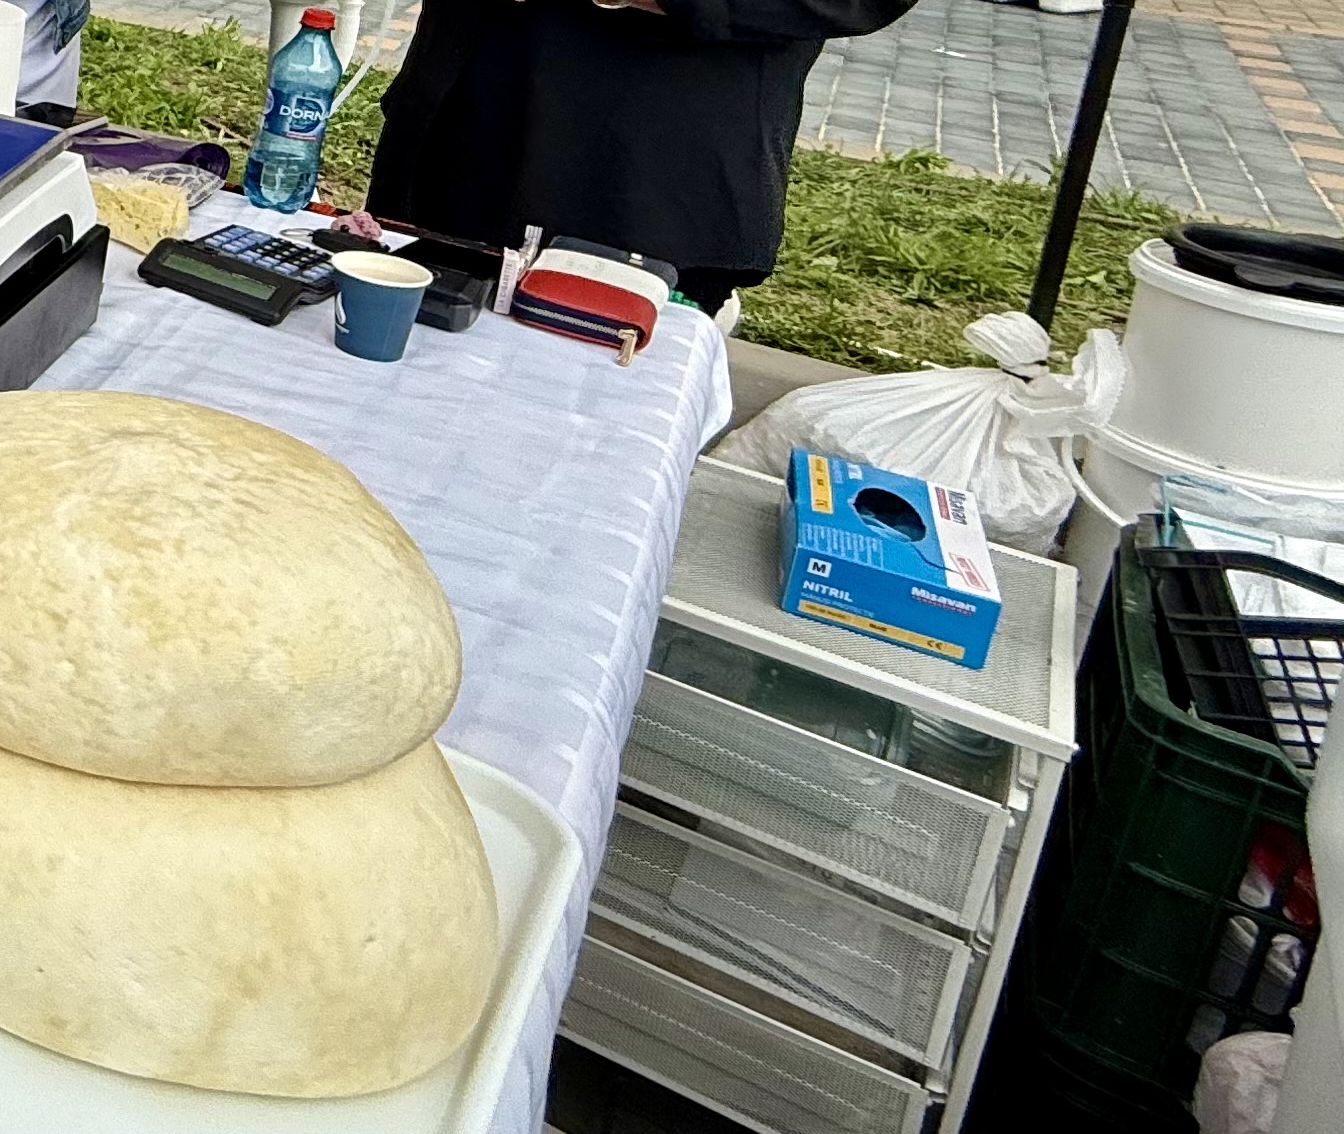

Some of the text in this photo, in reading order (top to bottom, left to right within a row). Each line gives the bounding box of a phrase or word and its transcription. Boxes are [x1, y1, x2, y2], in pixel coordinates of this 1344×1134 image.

[811, 561, 827, 575] M
[802, 579, 854, 603] NITRIL
[910, 586, 977, 612] Misavan
